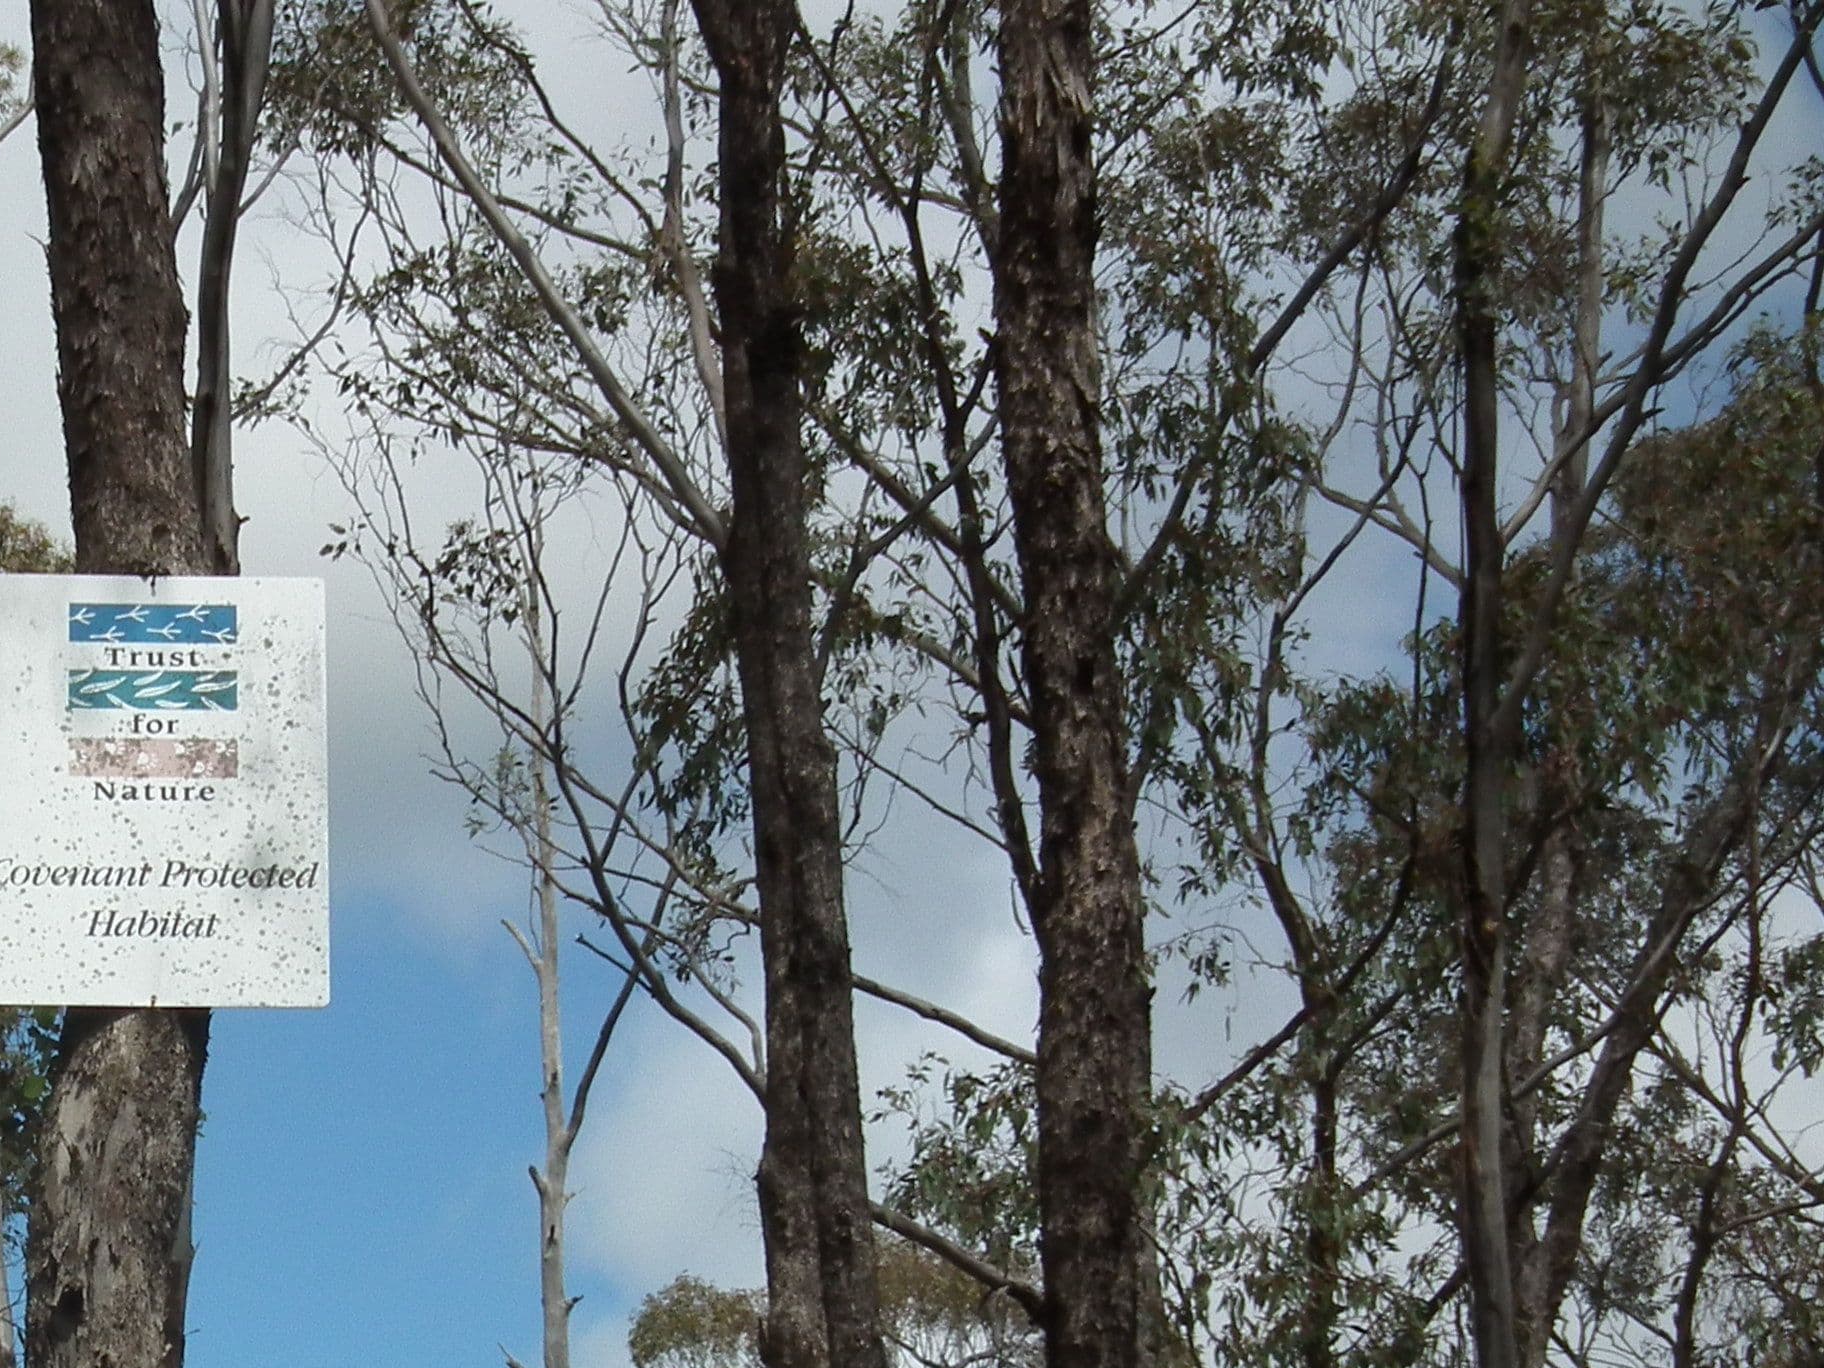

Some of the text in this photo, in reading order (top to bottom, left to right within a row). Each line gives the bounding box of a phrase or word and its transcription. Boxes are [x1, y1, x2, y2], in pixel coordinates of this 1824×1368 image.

[104, 646, 202, 668] Trust
[131, 712, 179, 734] for
[93, 781, 216, 802] Nature
[160, 860, 319, 890] Protected
[86, 911, 220, 939] Habitat
